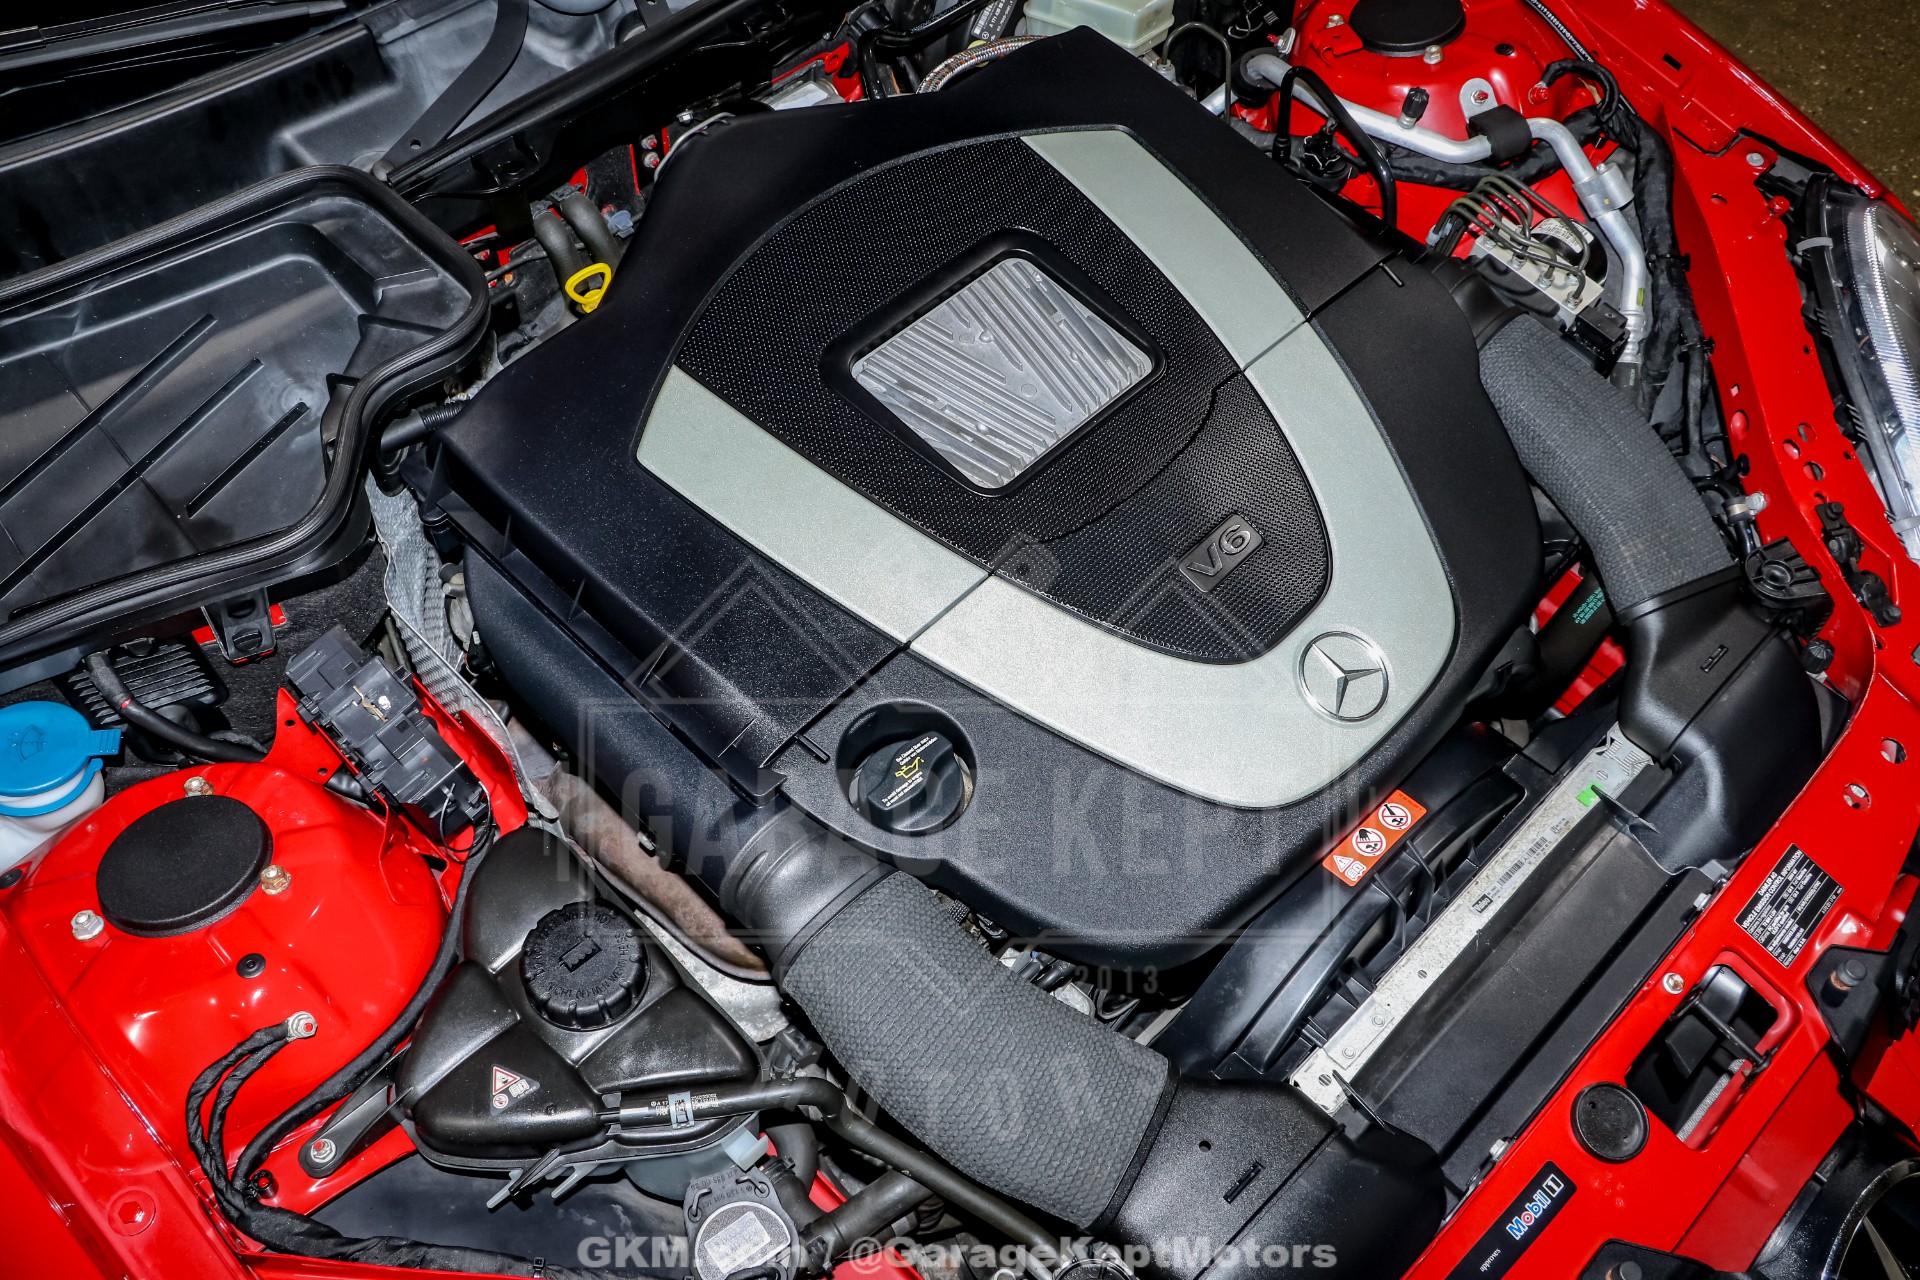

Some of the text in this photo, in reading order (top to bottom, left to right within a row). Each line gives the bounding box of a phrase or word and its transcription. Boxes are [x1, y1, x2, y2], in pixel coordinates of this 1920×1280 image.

[1185, 524, 1249, 576] V6
[1740, 909, 1757, 929] VEHICLE
[1753, 891, 1771, 913] EMISSION
[1767, 873, 1784, 894] CONTROL
[1779, 848, 1802, 877] INFORMATION
[1505, 1188, 1552, 1240] Mobil
